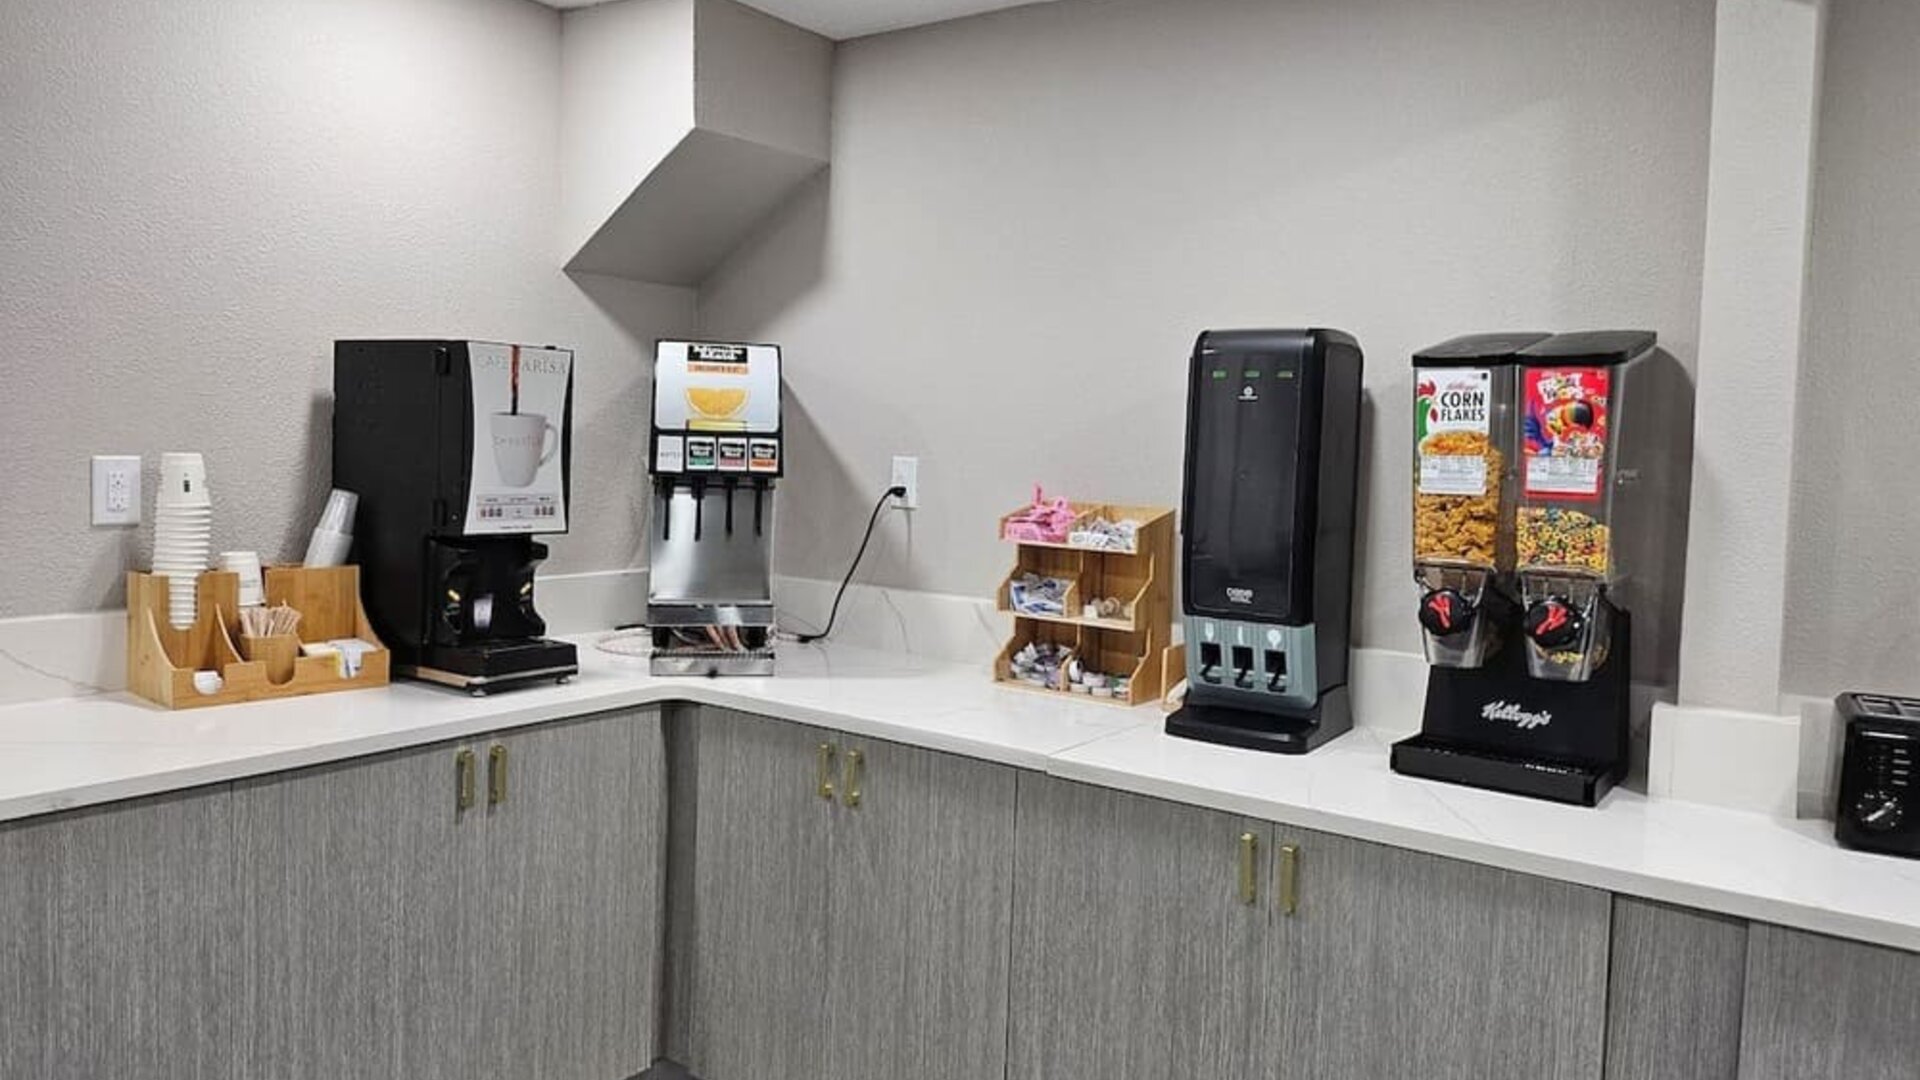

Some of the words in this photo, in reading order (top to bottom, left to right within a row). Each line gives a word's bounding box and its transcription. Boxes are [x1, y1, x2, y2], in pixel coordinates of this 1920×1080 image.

[1441, 391, 1485, 408] CORN
[1441, 408, 1485, 422] FLAKES
[1481, 700, 1552, 729] Kellogg's
